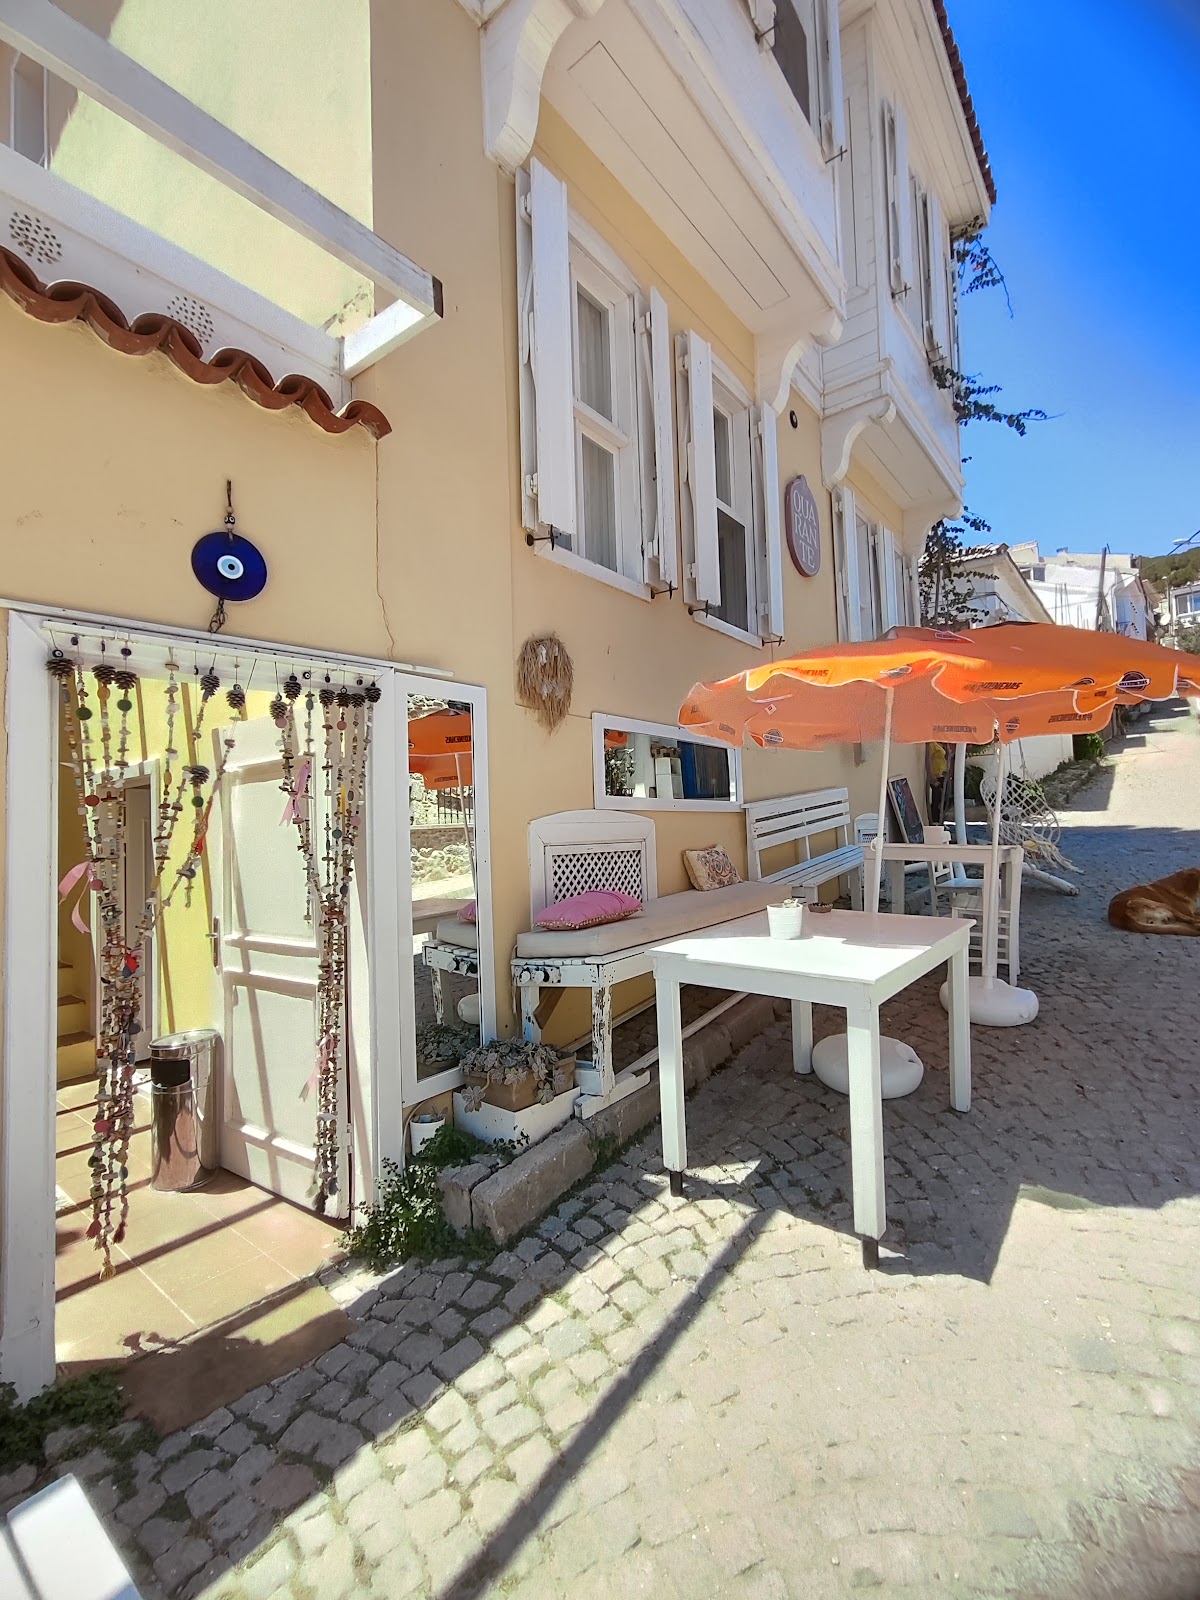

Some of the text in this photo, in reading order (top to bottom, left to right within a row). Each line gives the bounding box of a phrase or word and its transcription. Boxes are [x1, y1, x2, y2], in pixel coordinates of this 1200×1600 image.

[793, 489, 816, 526] QUA
[794, 513, 818, 549] RAN
[799, 540, 815, 568] TE
